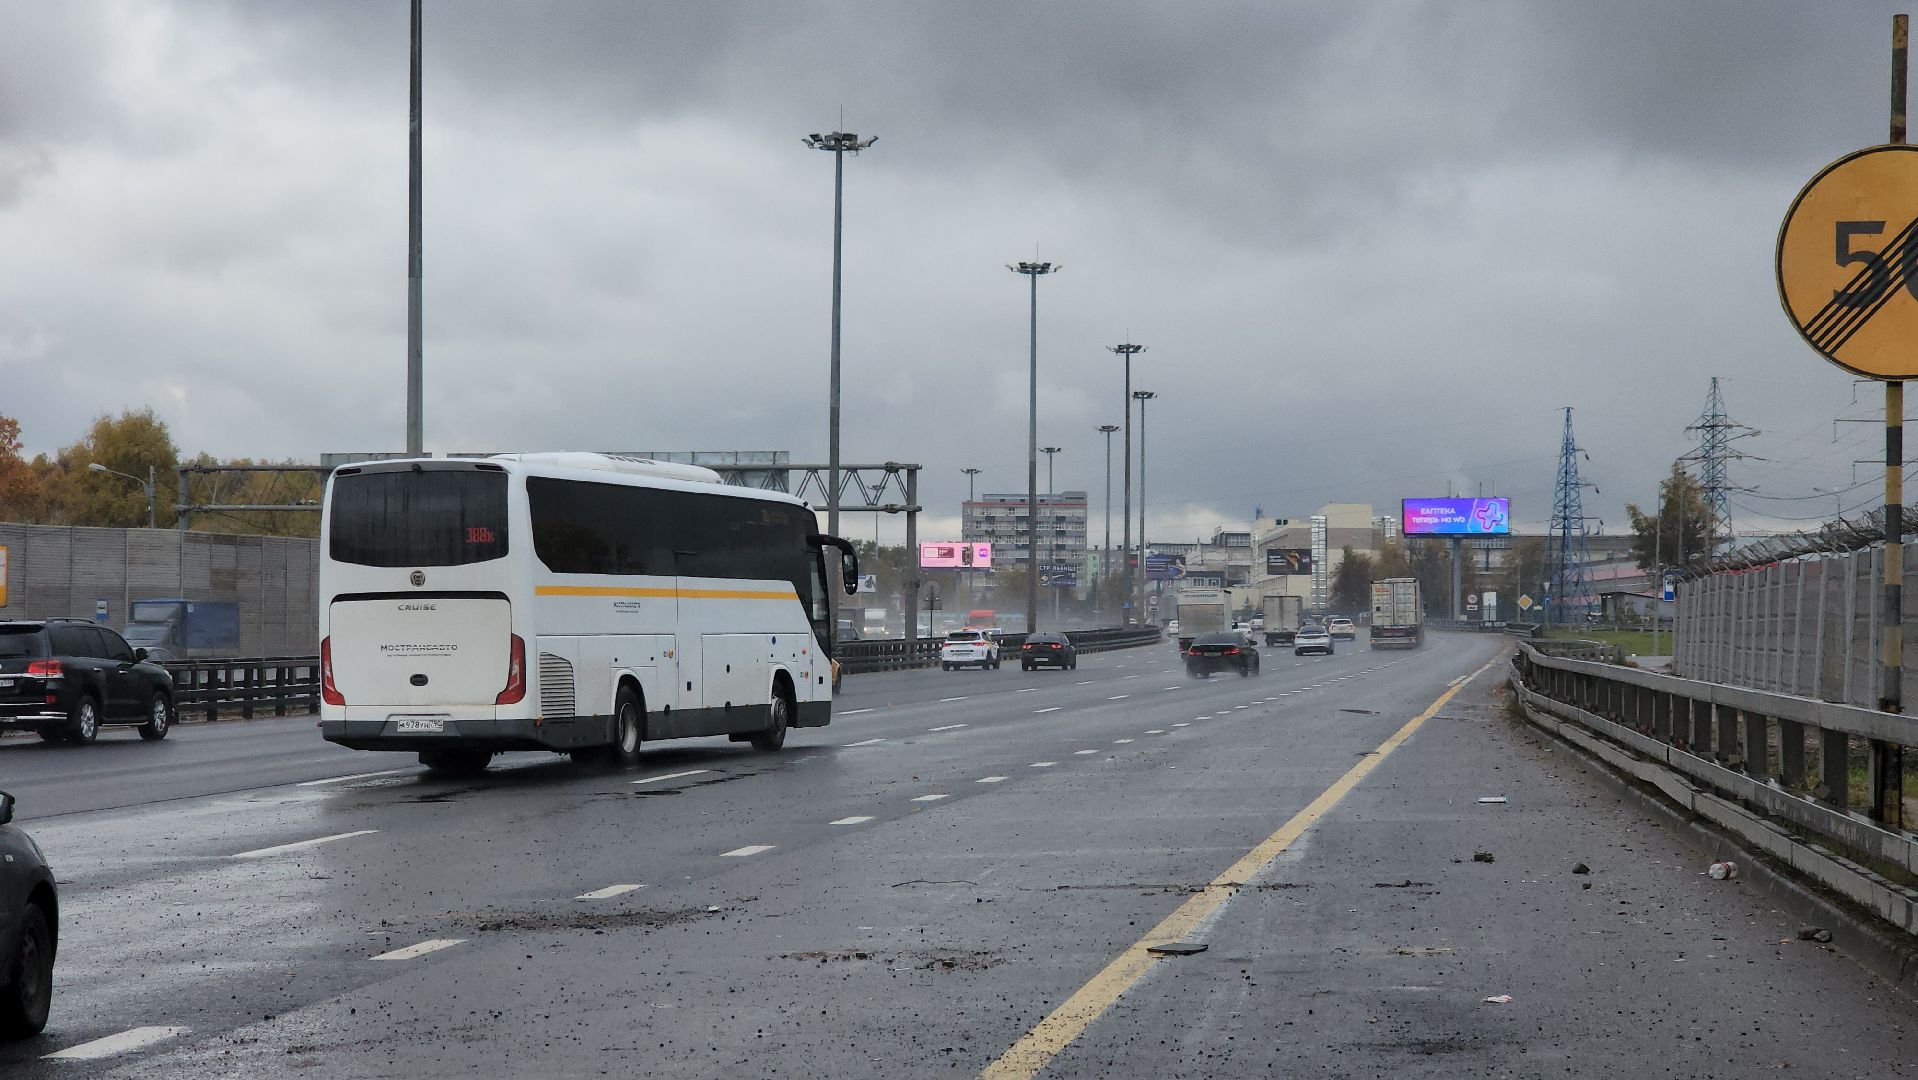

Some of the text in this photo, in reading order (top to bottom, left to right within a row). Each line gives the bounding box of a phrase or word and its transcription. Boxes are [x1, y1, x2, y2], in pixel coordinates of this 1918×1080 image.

[1833, 220, 1918, 308] 5
[1420, 507, 1456, 515] ЕАПТЕКА
[398, 603, 437, 611] CRUISE
[380, 644, 458, 652] МОСТРАНСАВТО
